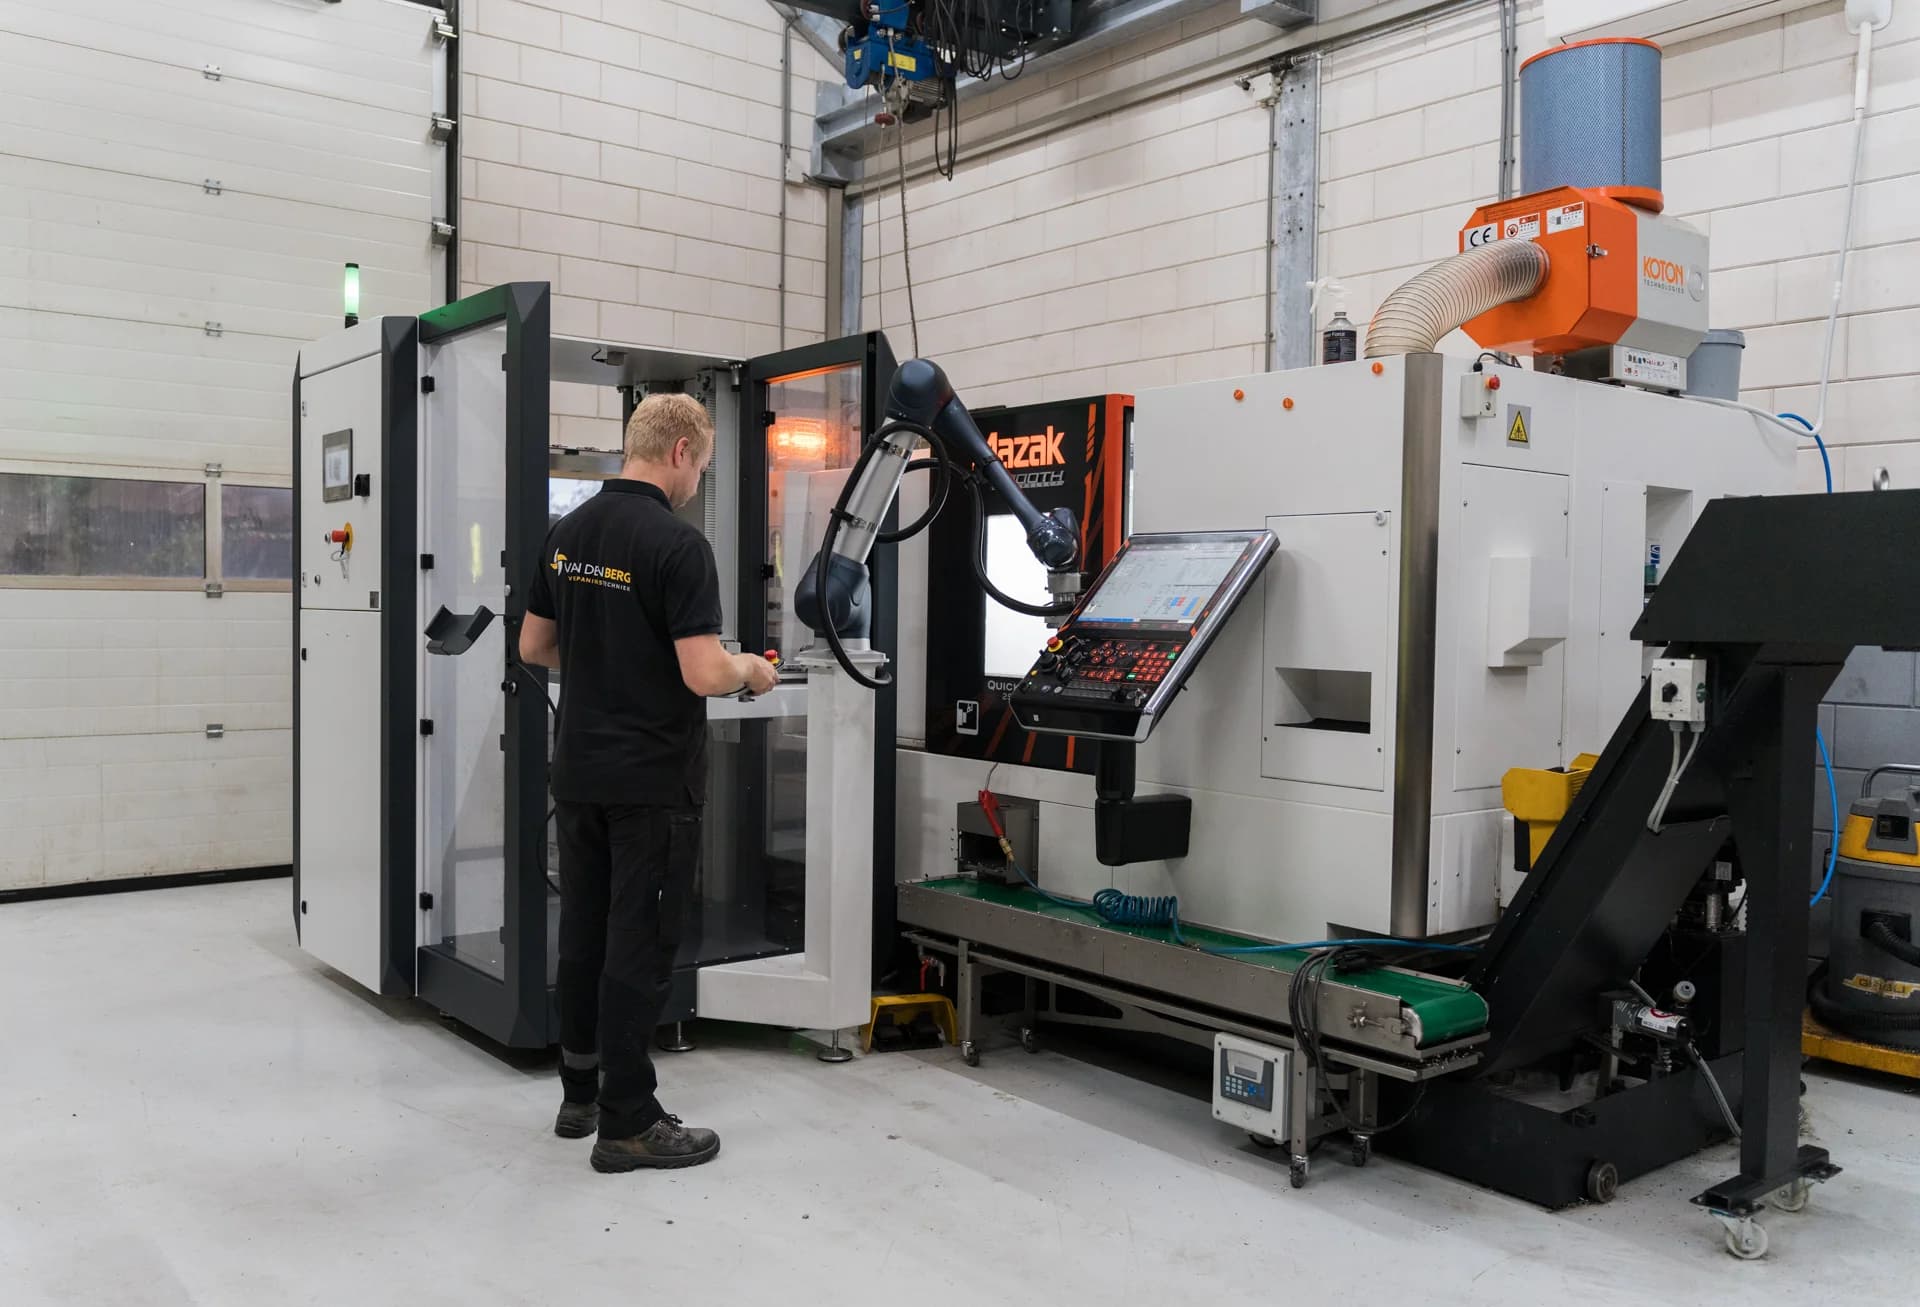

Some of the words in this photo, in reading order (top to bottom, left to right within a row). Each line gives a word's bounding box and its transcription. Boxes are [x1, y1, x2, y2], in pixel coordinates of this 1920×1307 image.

[1643, 255, 1684, 287] KOTON
[1643, 278, 1684, 294] TECHNOLOGIES
[1012, 470, 1065, 483] OOTH
